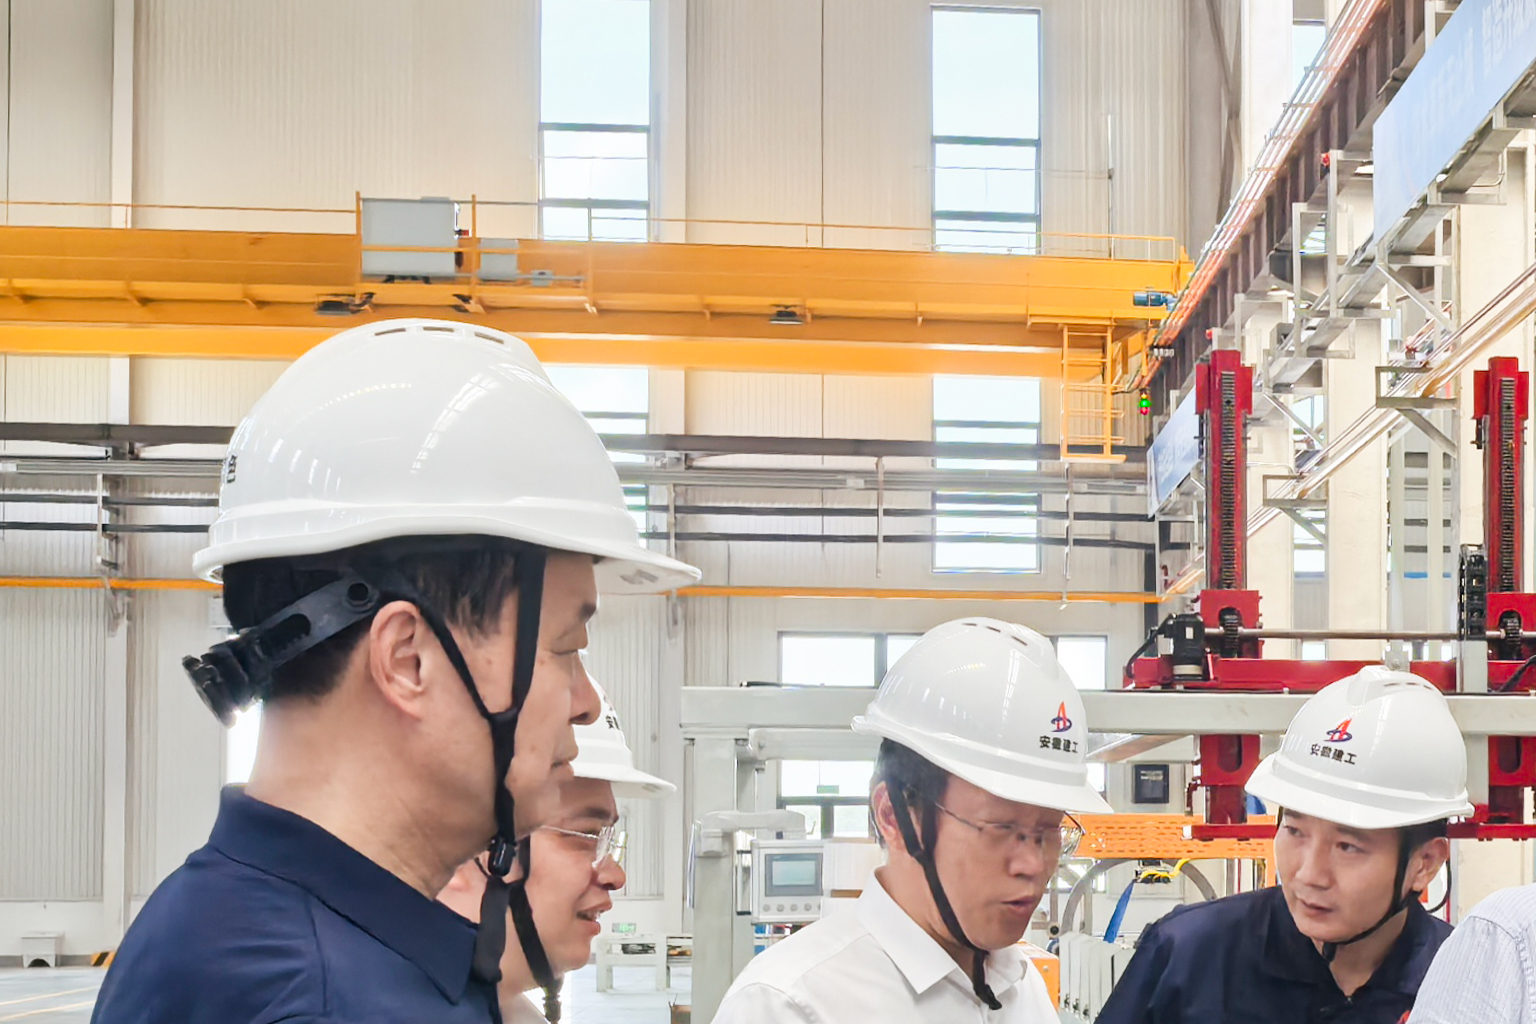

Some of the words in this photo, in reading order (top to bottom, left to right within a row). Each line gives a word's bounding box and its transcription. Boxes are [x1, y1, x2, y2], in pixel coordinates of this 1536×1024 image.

[1039, 735, 1079, 754] 安徽建工
[1309, 743, 1358, 765] 安徽建工
